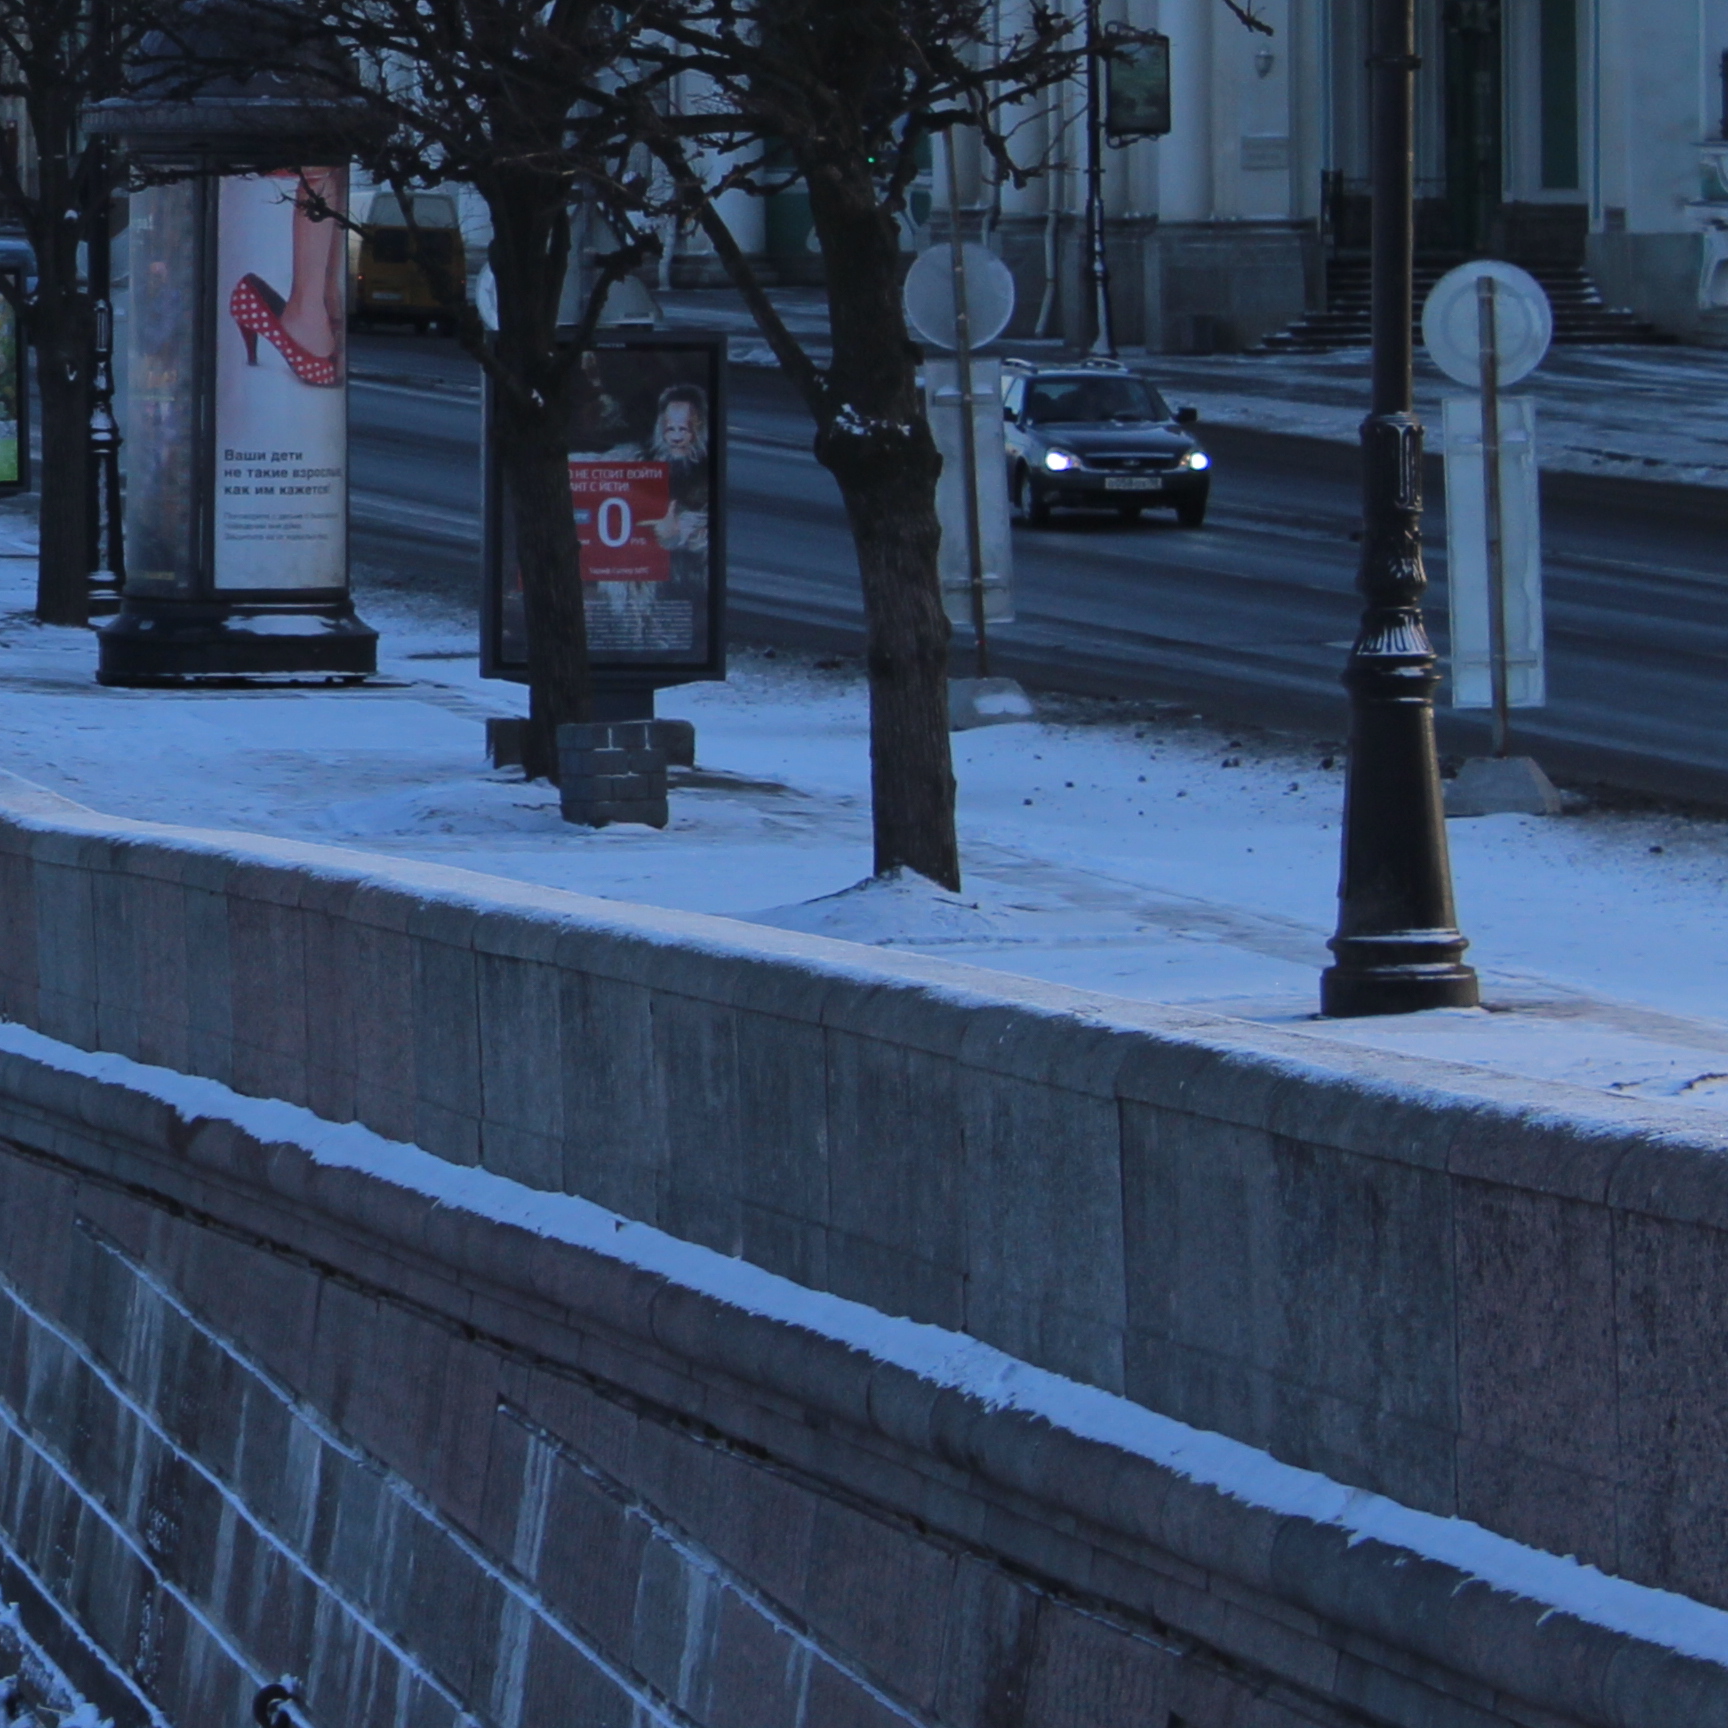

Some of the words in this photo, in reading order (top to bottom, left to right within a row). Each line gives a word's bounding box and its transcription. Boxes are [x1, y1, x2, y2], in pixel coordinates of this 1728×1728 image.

[224, 449, 266, 461] Ваши
[270, 451, 303, 463] дети
[224, 468, 242, 478] не
[247, 468, 289, 478] такие
[575, 469, 589, 479] НЕ
[591, 469, 624, 479] СТОИТ
[626, 466, 663, 479] ВОЙТИ
[224, 485, 250, 495] как
[255, 485, 275, 495] им
[597, 497, 632, 547] 0
